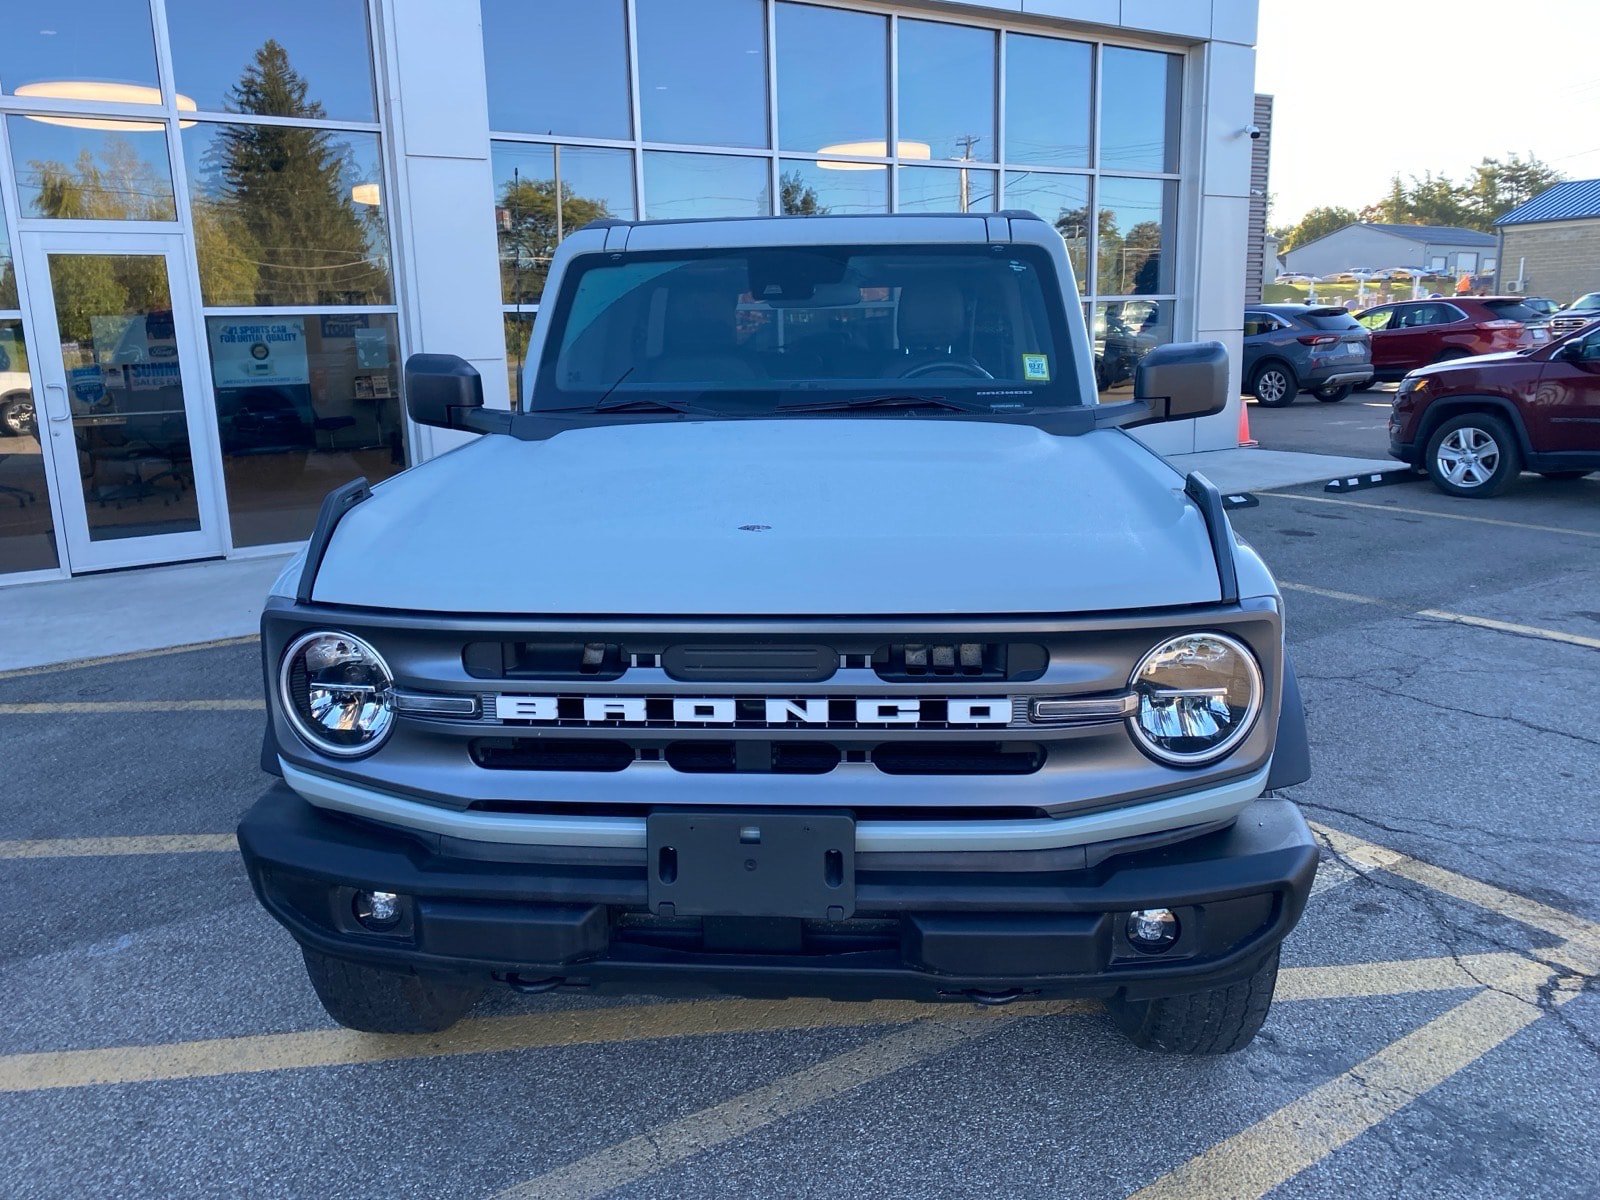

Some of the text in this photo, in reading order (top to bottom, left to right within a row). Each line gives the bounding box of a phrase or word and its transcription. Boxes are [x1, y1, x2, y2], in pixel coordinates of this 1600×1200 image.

[239, 325, 269, 334] SPORTS
[220, 334, 236, 343] FOR
[266, 333, 297, 344] QUALITY
[496, 695, 1013, 724] BRONCO
